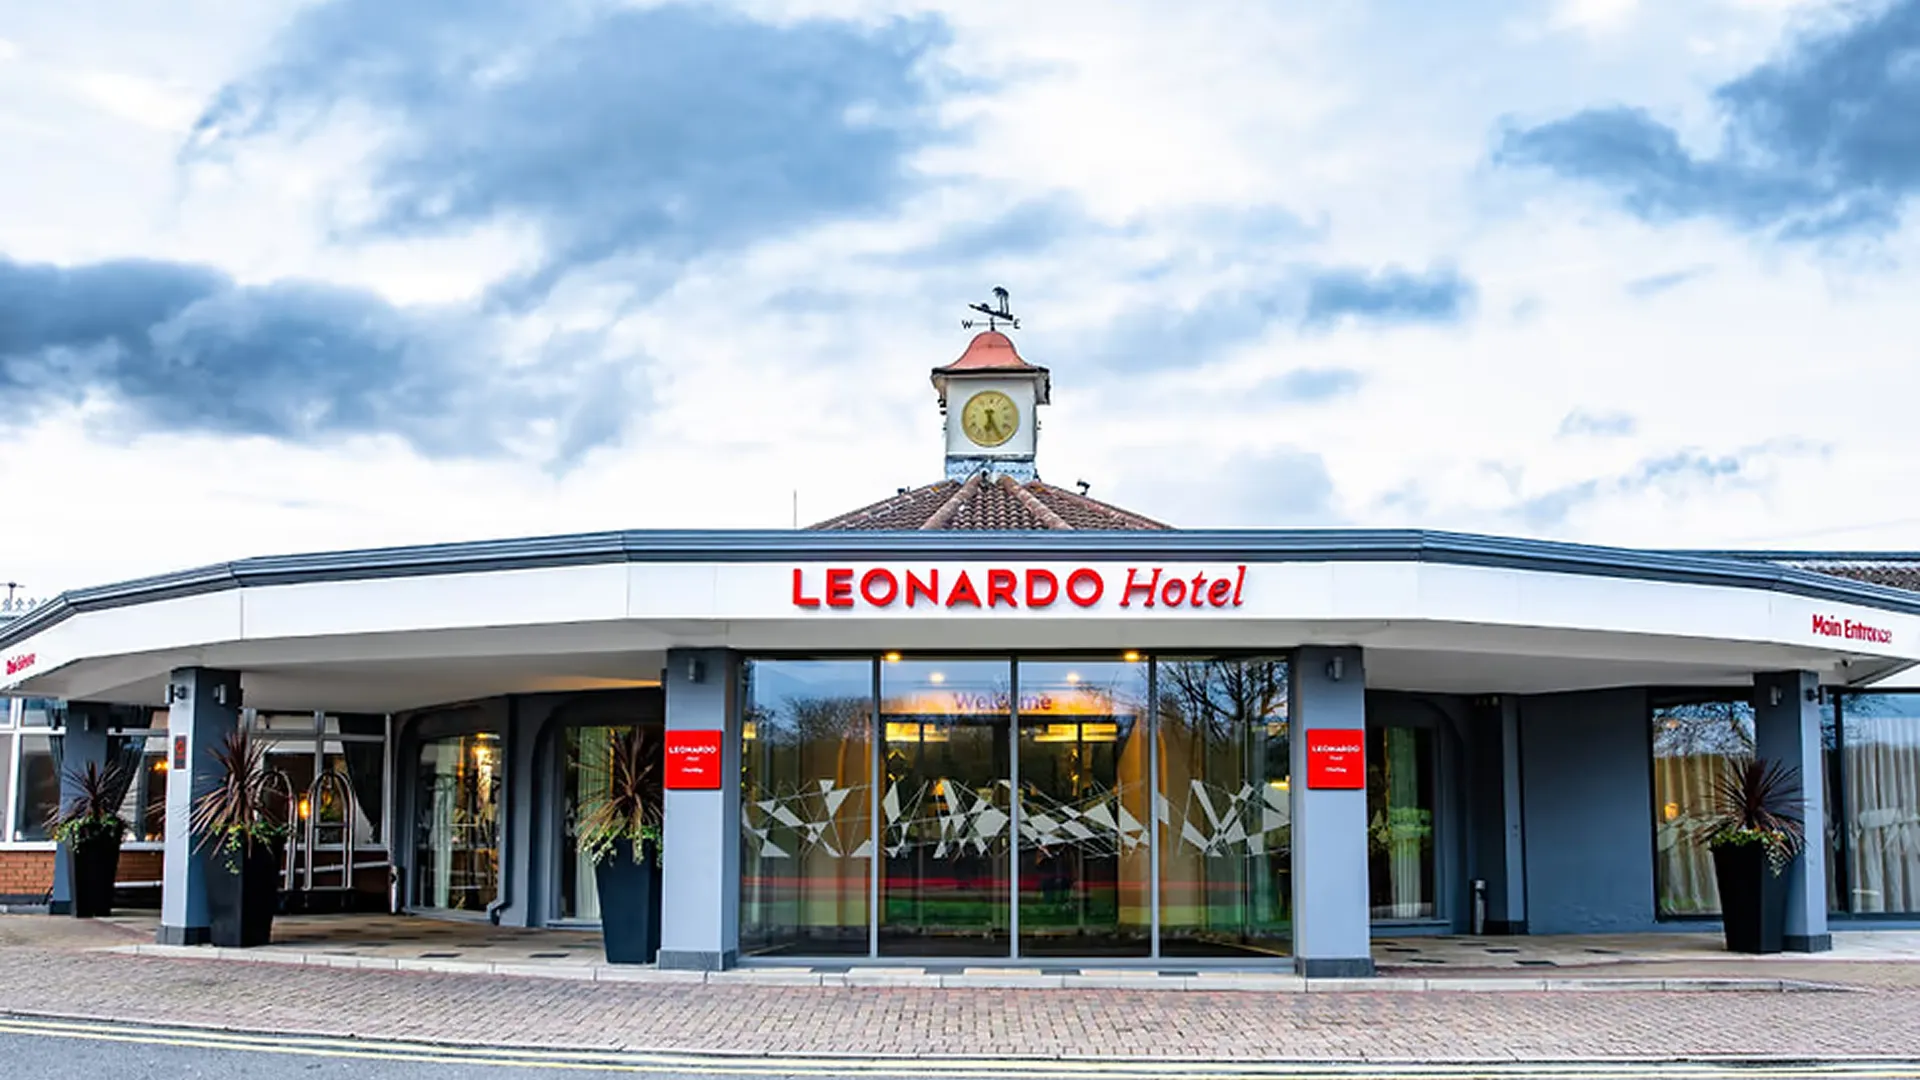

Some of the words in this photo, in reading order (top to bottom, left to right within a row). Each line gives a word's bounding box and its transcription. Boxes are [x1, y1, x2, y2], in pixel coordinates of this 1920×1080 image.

[961, 319, 973, 329] W
[793, 567, 1104, 607] LEONARDO
[1119, 565, 1246, 607] Hotel
[1812, 614, 1842, 636] Main
[1844, 619, 1892, 643] Entrance
[668, 746, 717, 754] LEONARDO
[1311, 745, 1361, 753] LEONARDO
